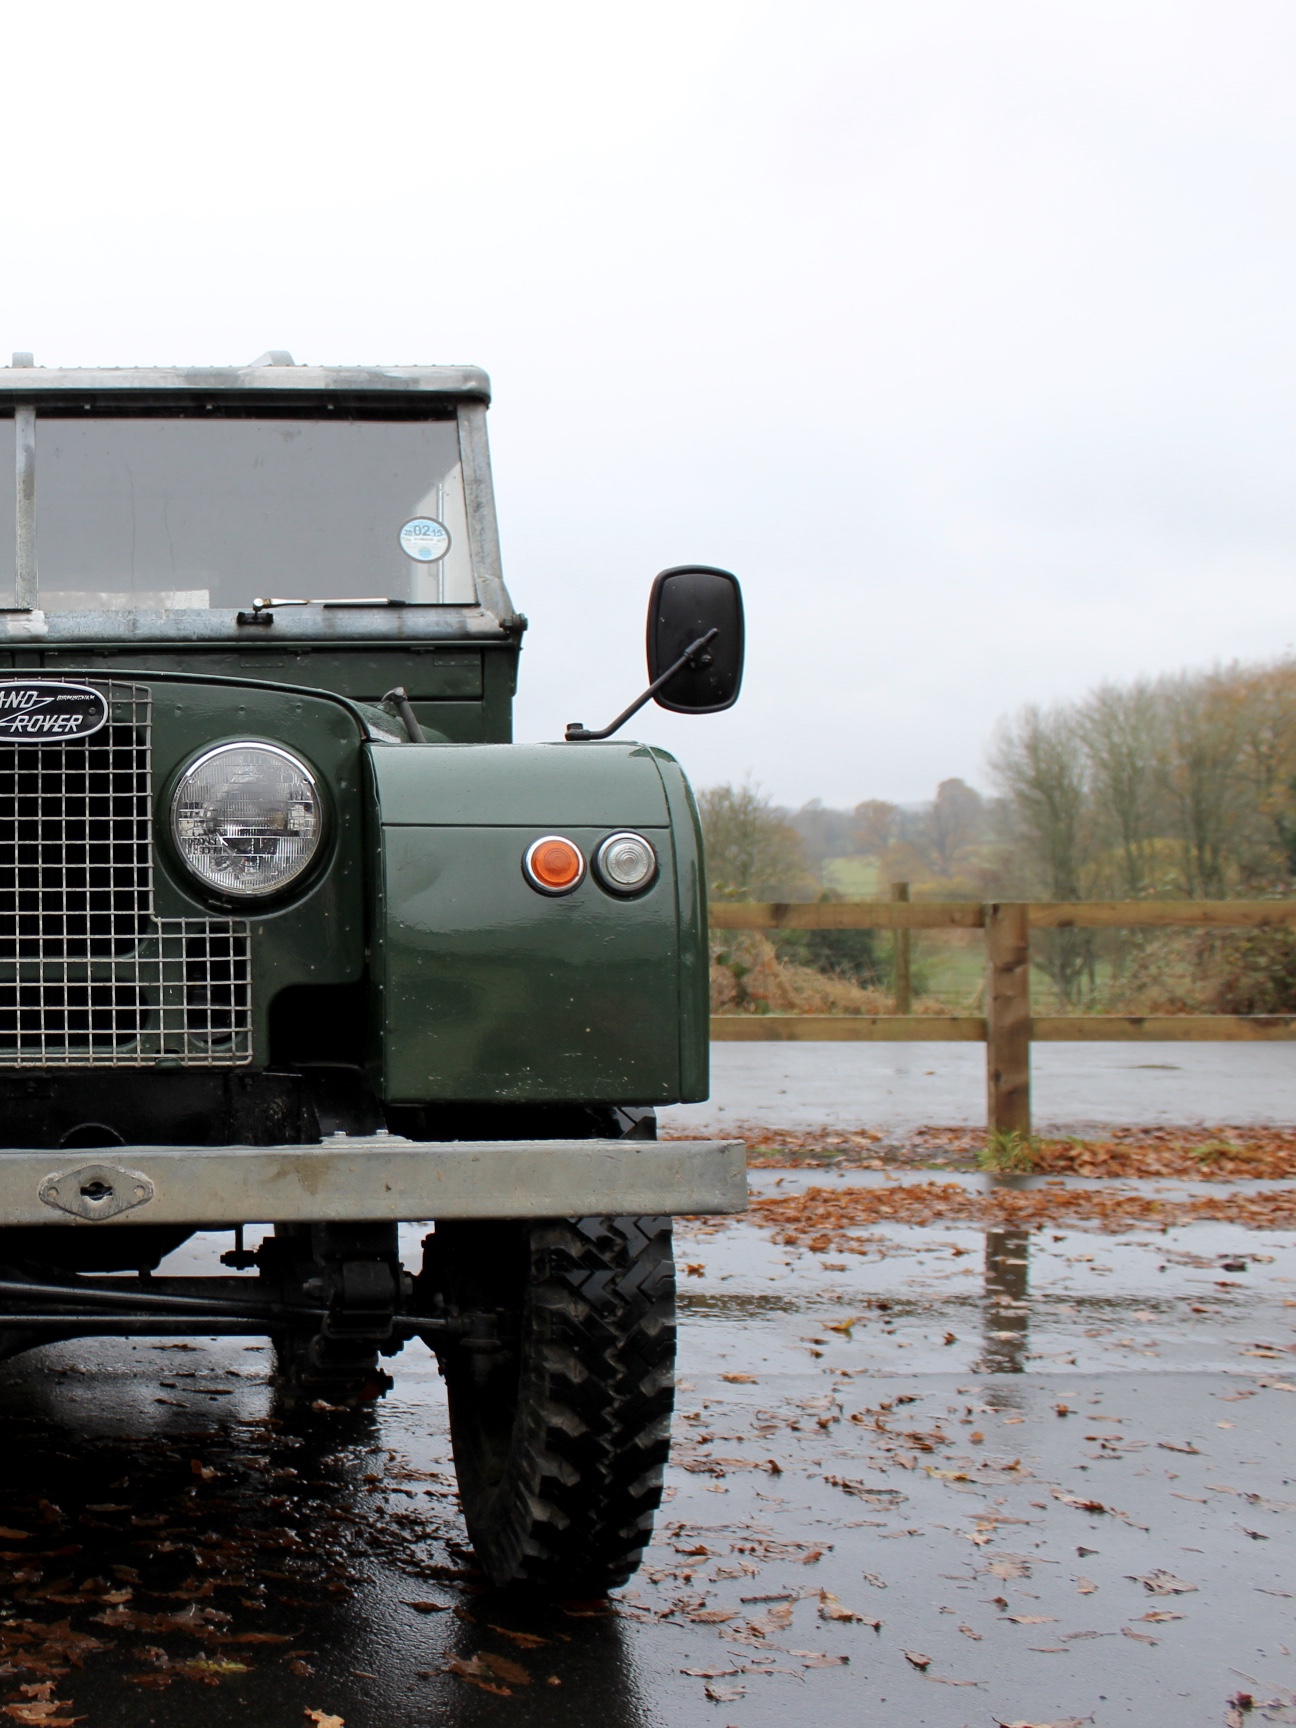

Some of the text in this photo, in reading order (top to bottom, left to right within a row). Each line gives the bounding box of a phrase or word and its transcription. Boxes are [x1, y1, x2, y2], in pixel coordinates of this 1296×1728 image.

[413, 525, 431, 536] 02
[432, 528, 443, 537] 15
[10, 715, 83, 732] ROVER
